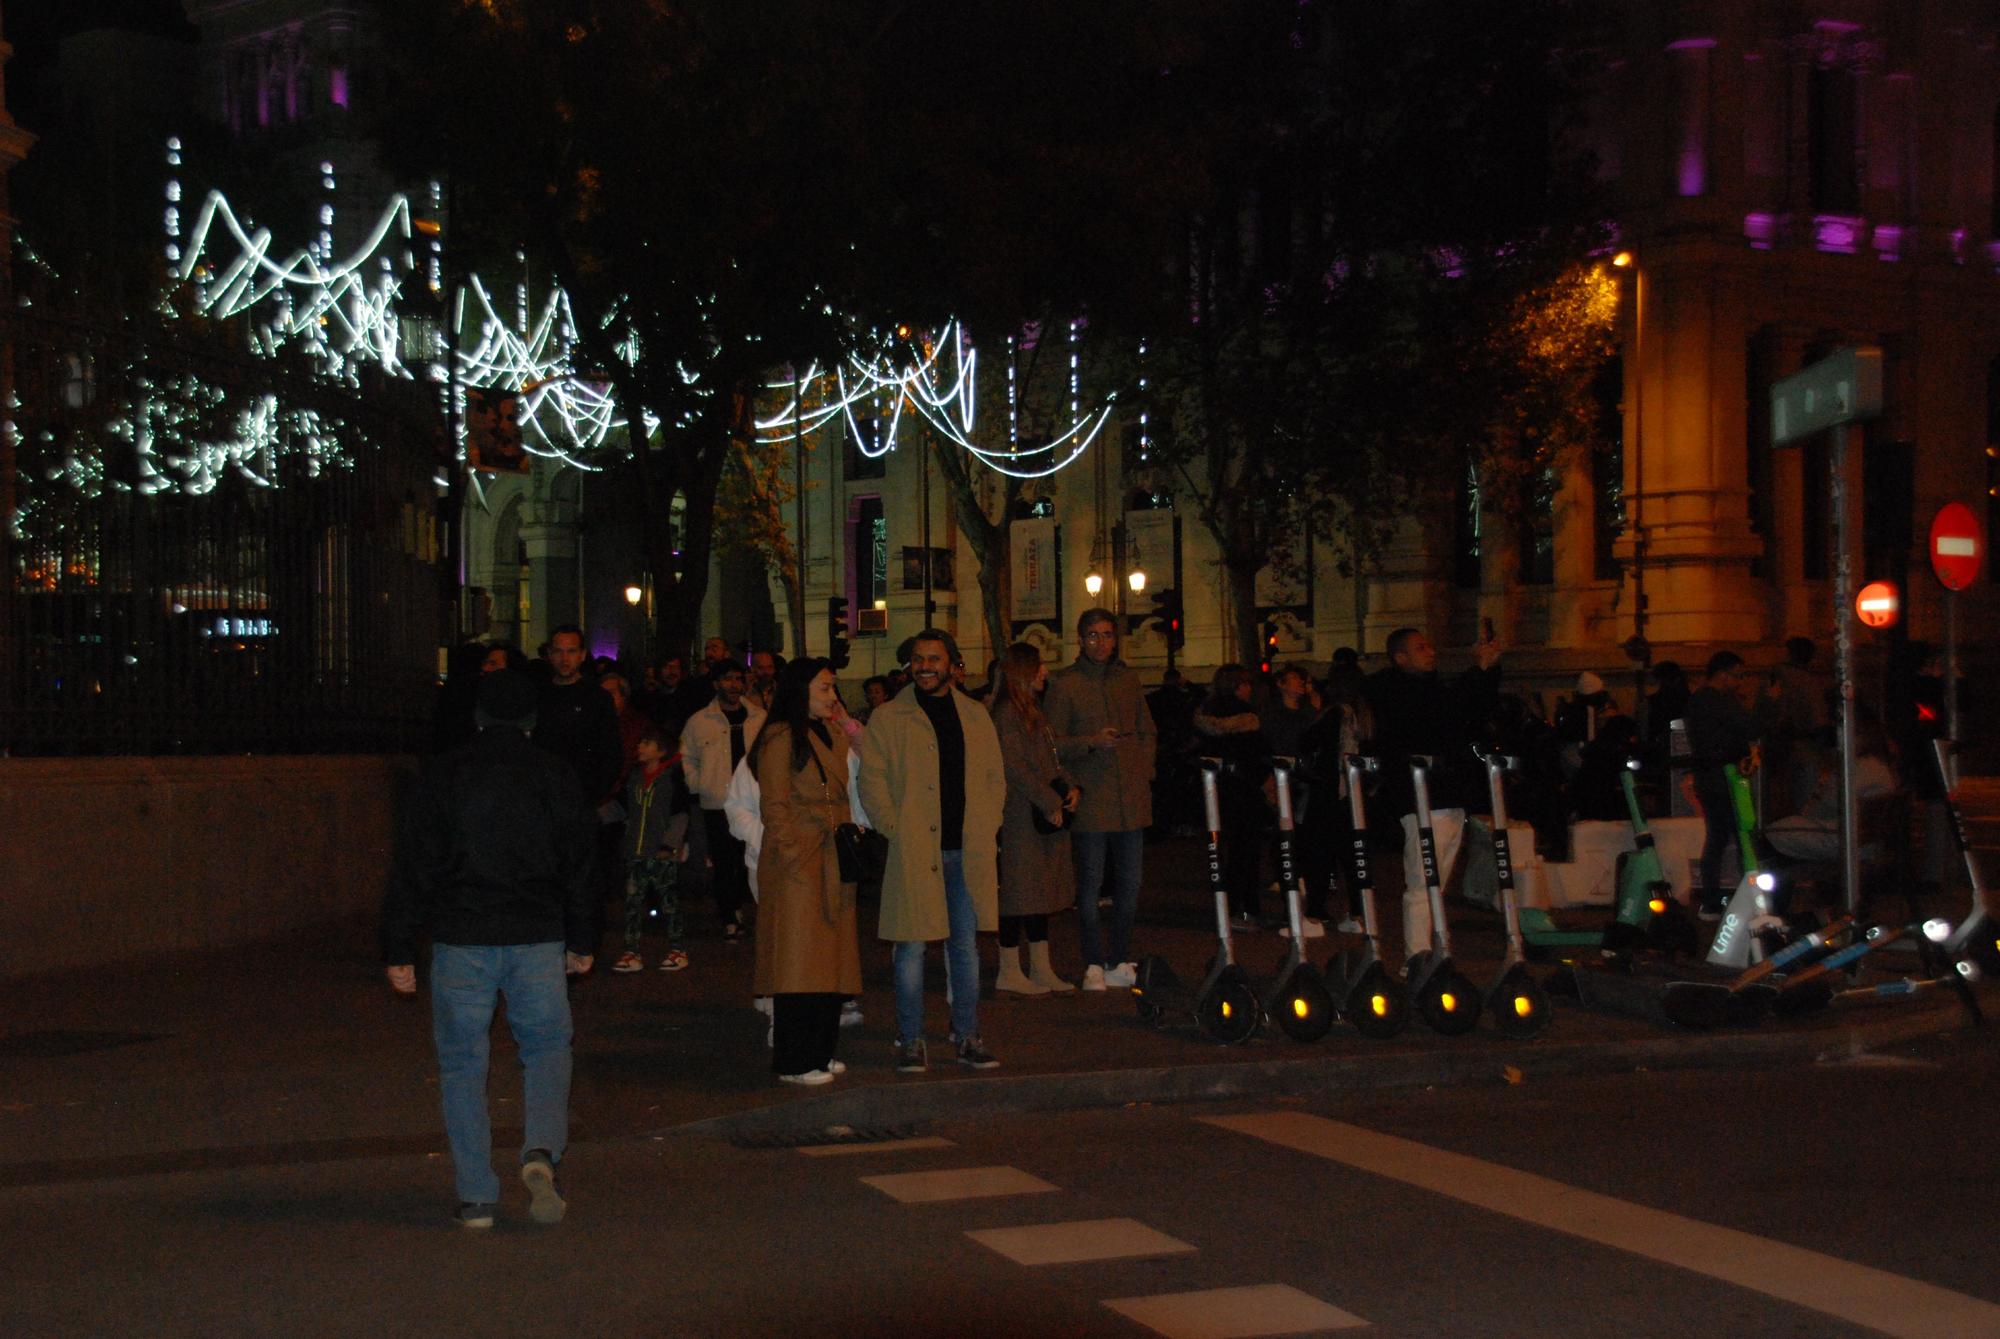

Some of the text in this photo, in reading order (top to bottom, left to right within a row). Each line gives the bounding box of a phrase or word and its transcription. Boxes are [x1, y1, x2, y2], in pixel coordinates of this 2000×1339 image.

[1208, 842, 1220, 882] BIRD
[1280, 840, 1292, 880] BIRD
[1353, 839, 1366, 879] BIRD
[1421, 838, 1433, 877] BIRD
[1496, 839, 1509, 879] BIRD
[1712, 913, 1739, 954] Lime
